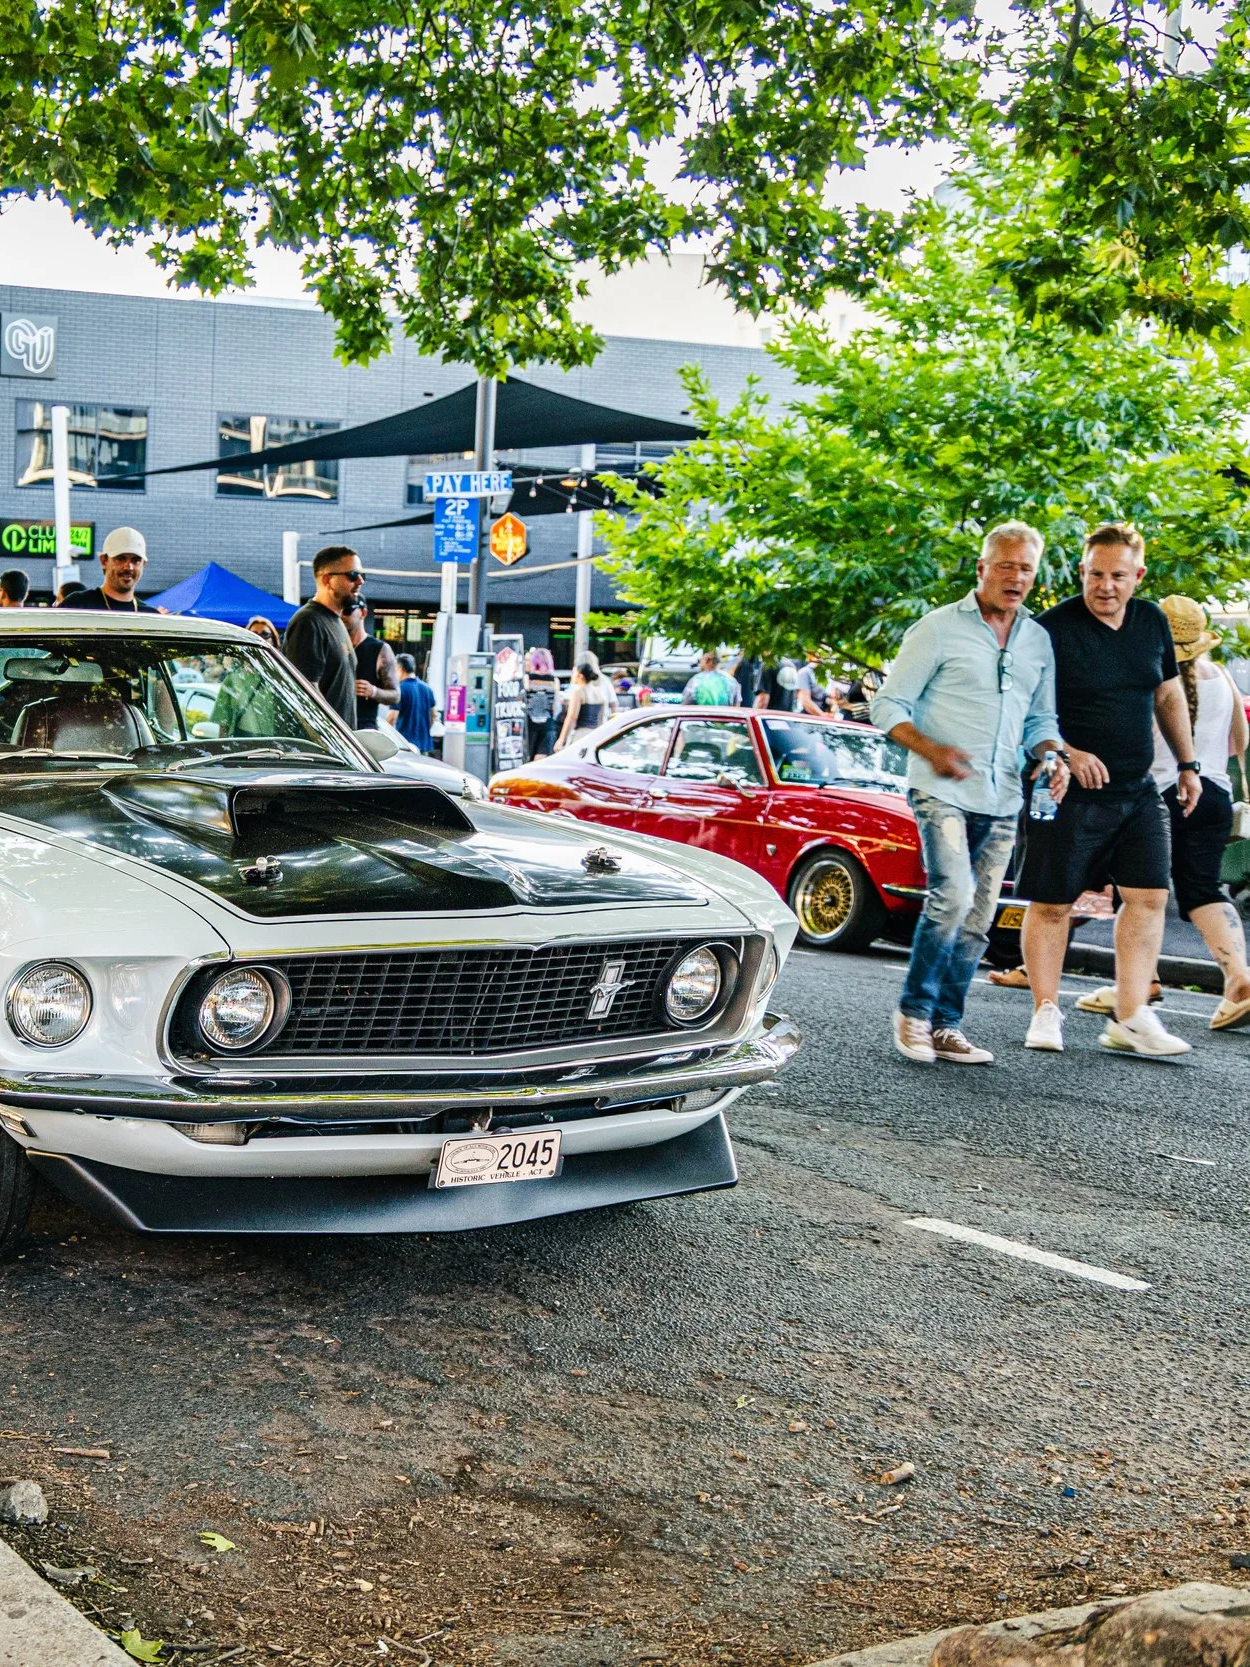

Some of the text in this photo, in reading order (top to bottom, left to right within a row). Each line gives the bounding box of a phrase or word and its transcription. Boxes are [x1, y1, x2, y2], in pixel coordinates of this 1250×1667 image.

[432, 473, 510, 494] PAY HERE
[445, 499, 469, 515] 2P
[28, 524, 57, 540] CLU
[28, 539, 57, 554] LIM
[497, 1138, 554, 1170] 2045
[451, 1174, 486, 1183] HISTORIC
[490, 1171, 521, 1180] VEHICLE
